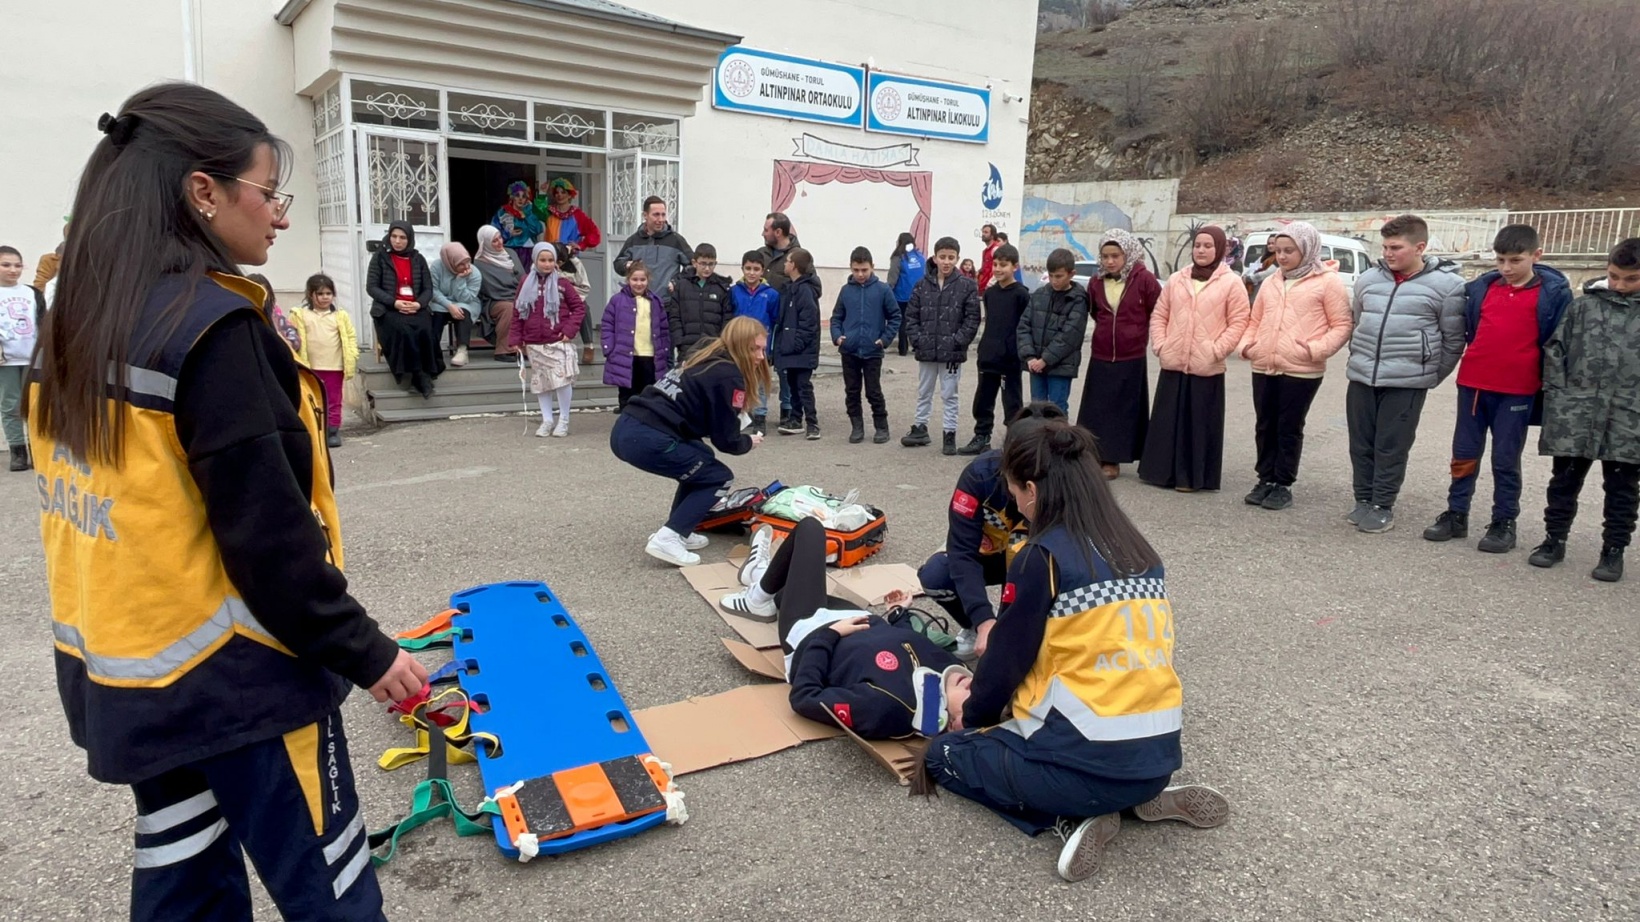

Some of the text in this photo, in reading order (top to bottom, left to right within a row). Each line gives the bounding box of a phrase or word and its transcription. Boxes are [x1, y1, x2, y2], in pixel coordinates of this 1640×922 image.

[805, 75, 825, 86] TORUL
[759, 82, 853, 110] ALTINPINAR ORTAOKULU
[943, 97, 960, 107] TORUL
[907, 106, 981, 127] ALTINPINAR İLKOKULU
[326, 741, 342, 815] SAĞLIK
